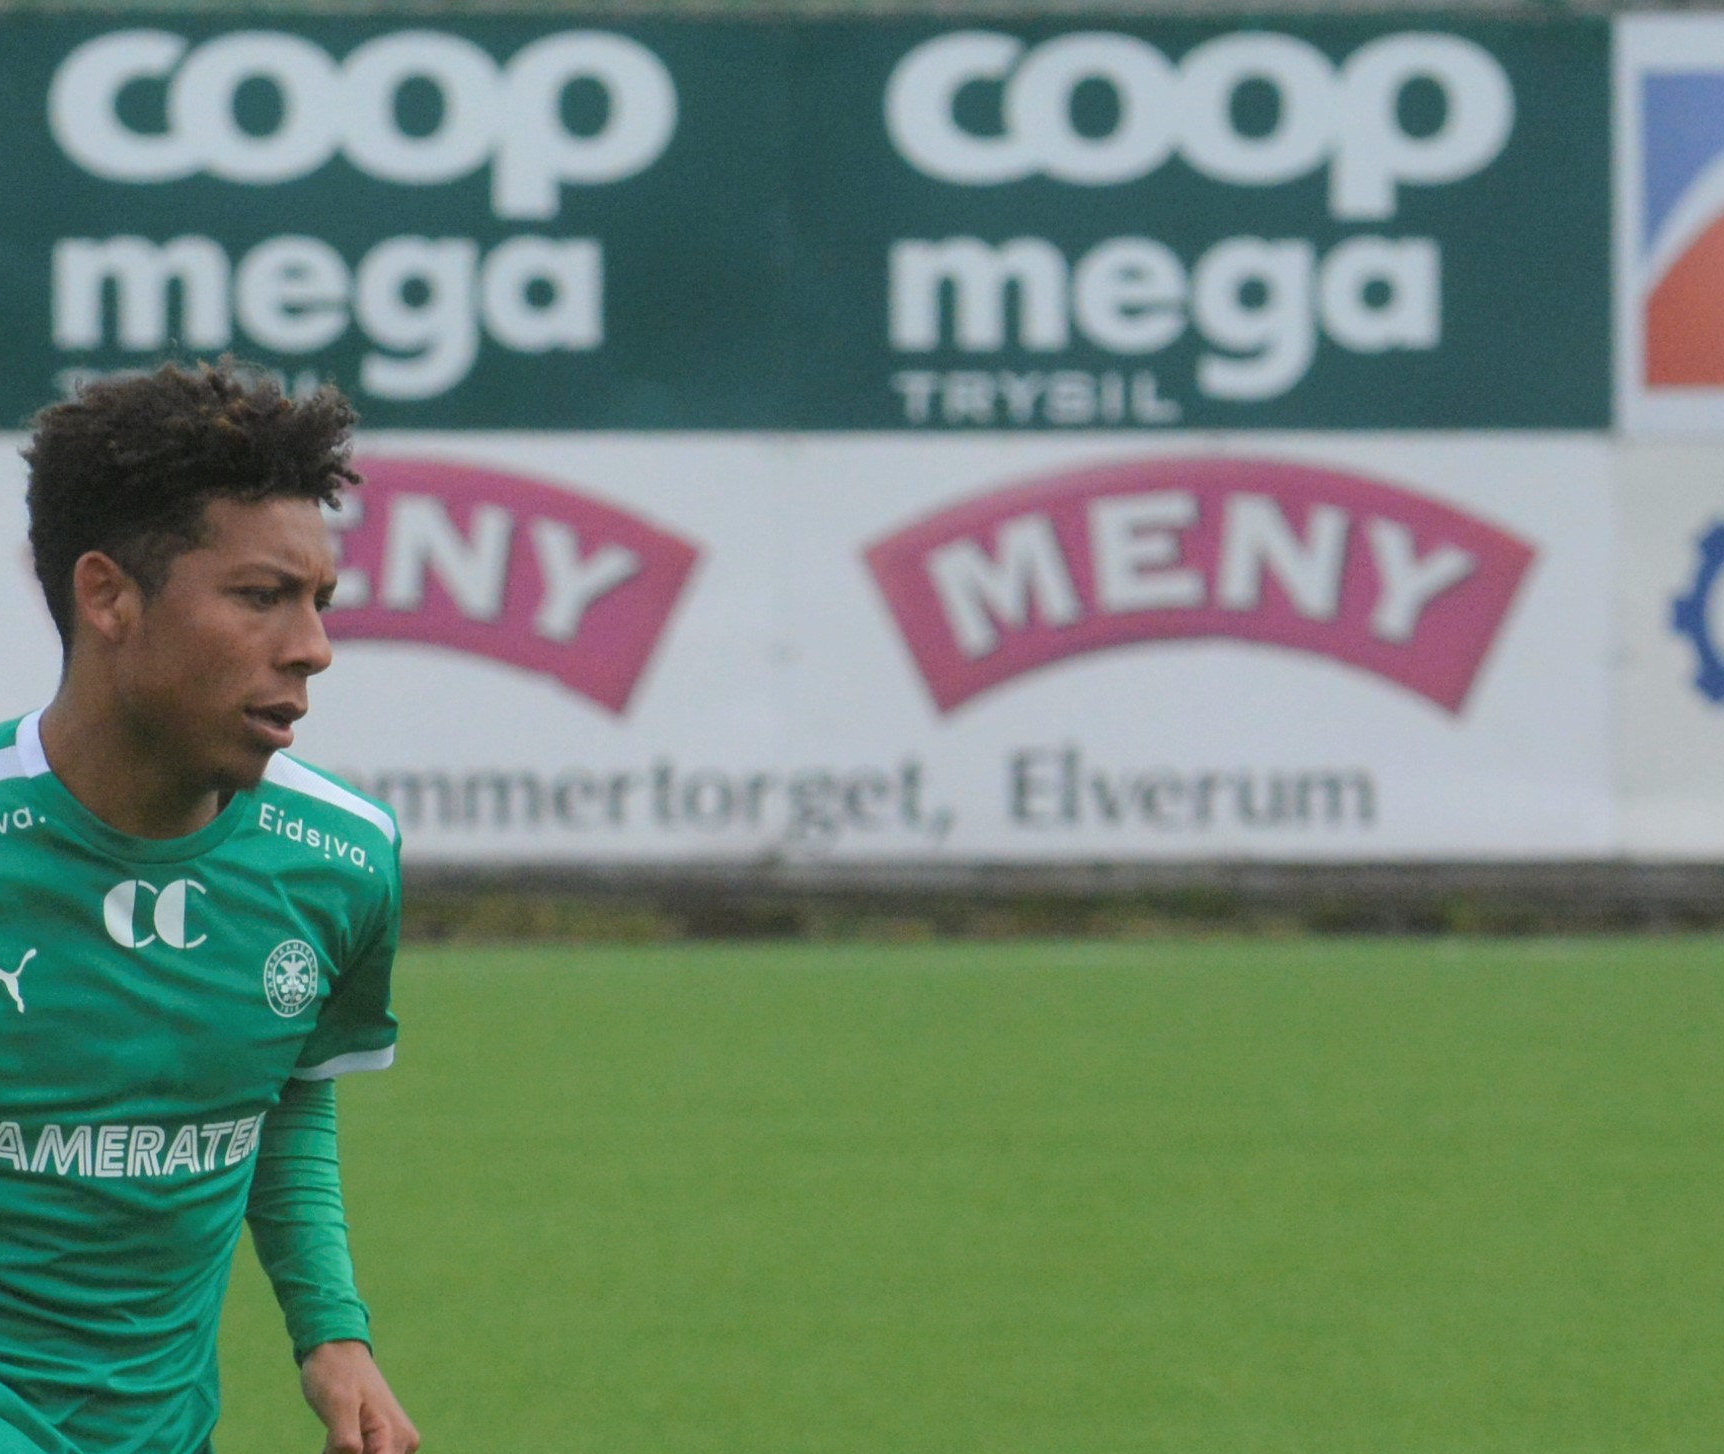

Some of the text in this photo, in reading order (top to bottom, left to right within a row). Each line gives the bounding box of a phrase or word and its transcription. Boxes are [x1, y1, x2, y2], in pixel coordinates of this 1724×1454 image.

[46, 28, 678, 220] coop
[884, 28, 1518, 222] coop
[51, 233, 606, 400] mega
[888, 233, 1444, 400] mega
[319, 488, 644, 645] NY
[924, 488, 1476, 662] MENY
[1008, 745, 1380, 832] Elverum
